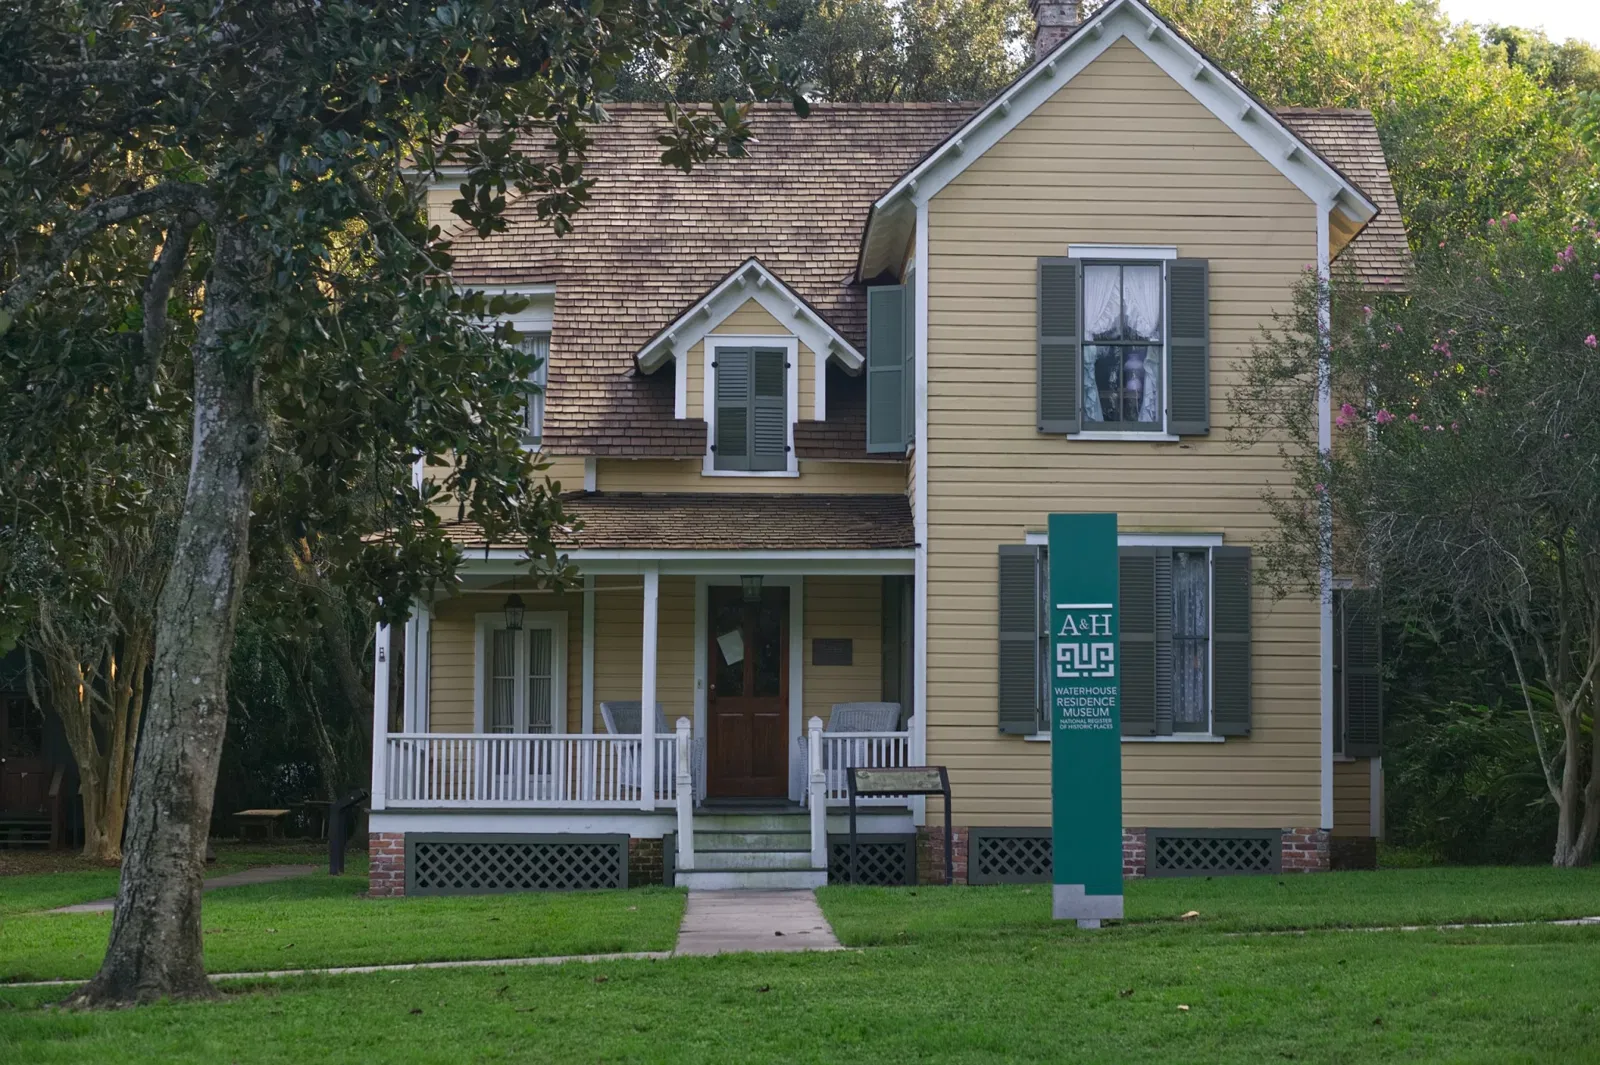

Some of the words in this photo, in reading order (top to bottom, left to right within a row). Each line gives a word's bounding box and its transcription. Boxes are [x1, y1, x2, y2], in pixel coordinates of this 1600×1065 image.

[1057, 614, 1112, 636] A&H
[1054, 686, 1117, 695] WATERHOUSE
[1057, 697, 1115, 706] RESIDENCE
[1063, 708, 1109, 717] MUSEUM
